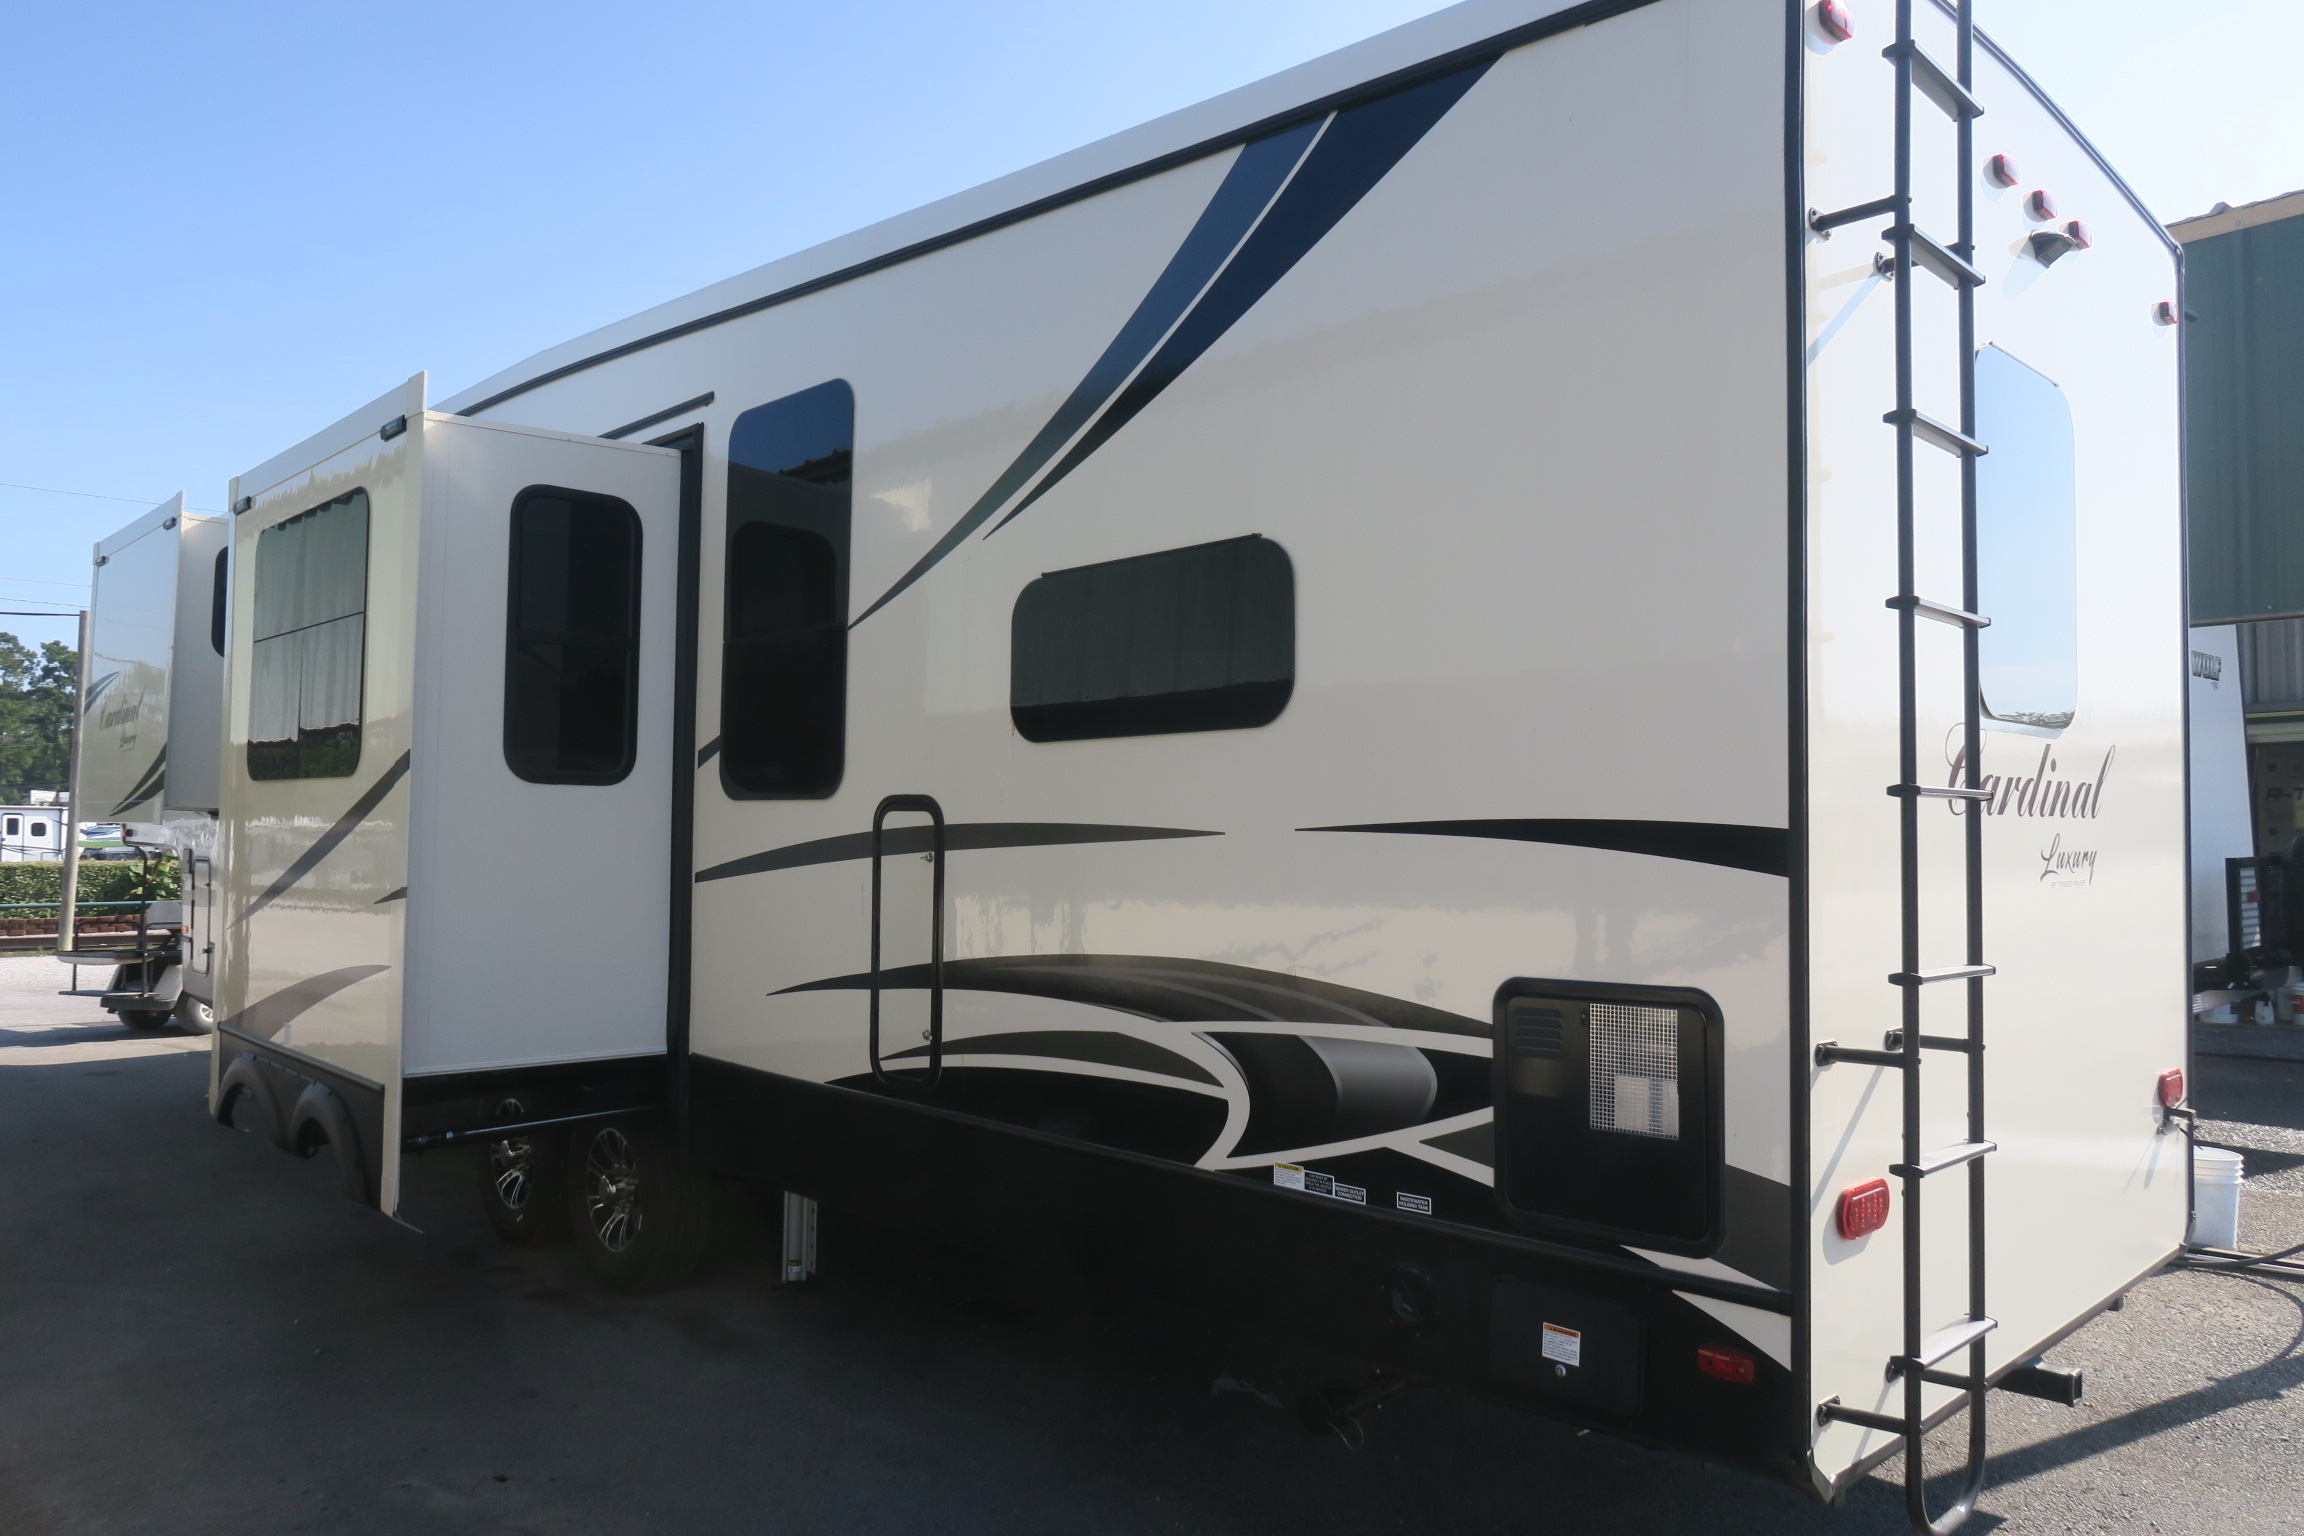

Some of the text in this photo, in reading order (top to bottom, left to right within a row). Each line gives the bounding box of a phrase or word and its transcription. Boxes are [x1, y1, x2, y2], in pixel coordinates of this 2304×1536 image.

[2191, 650, 2221, 681] WOLF
[2040, 833, 2098, 887] Luxury
[1335, 1185, 1364, 1196] SEWER OUTLET
[1337, 1191, 1363, 1201] CONNECTION
[1399, 1196, 1428, 1205] WASTEWATER
[1399, 1200, 1417, 1209] HOLDING
